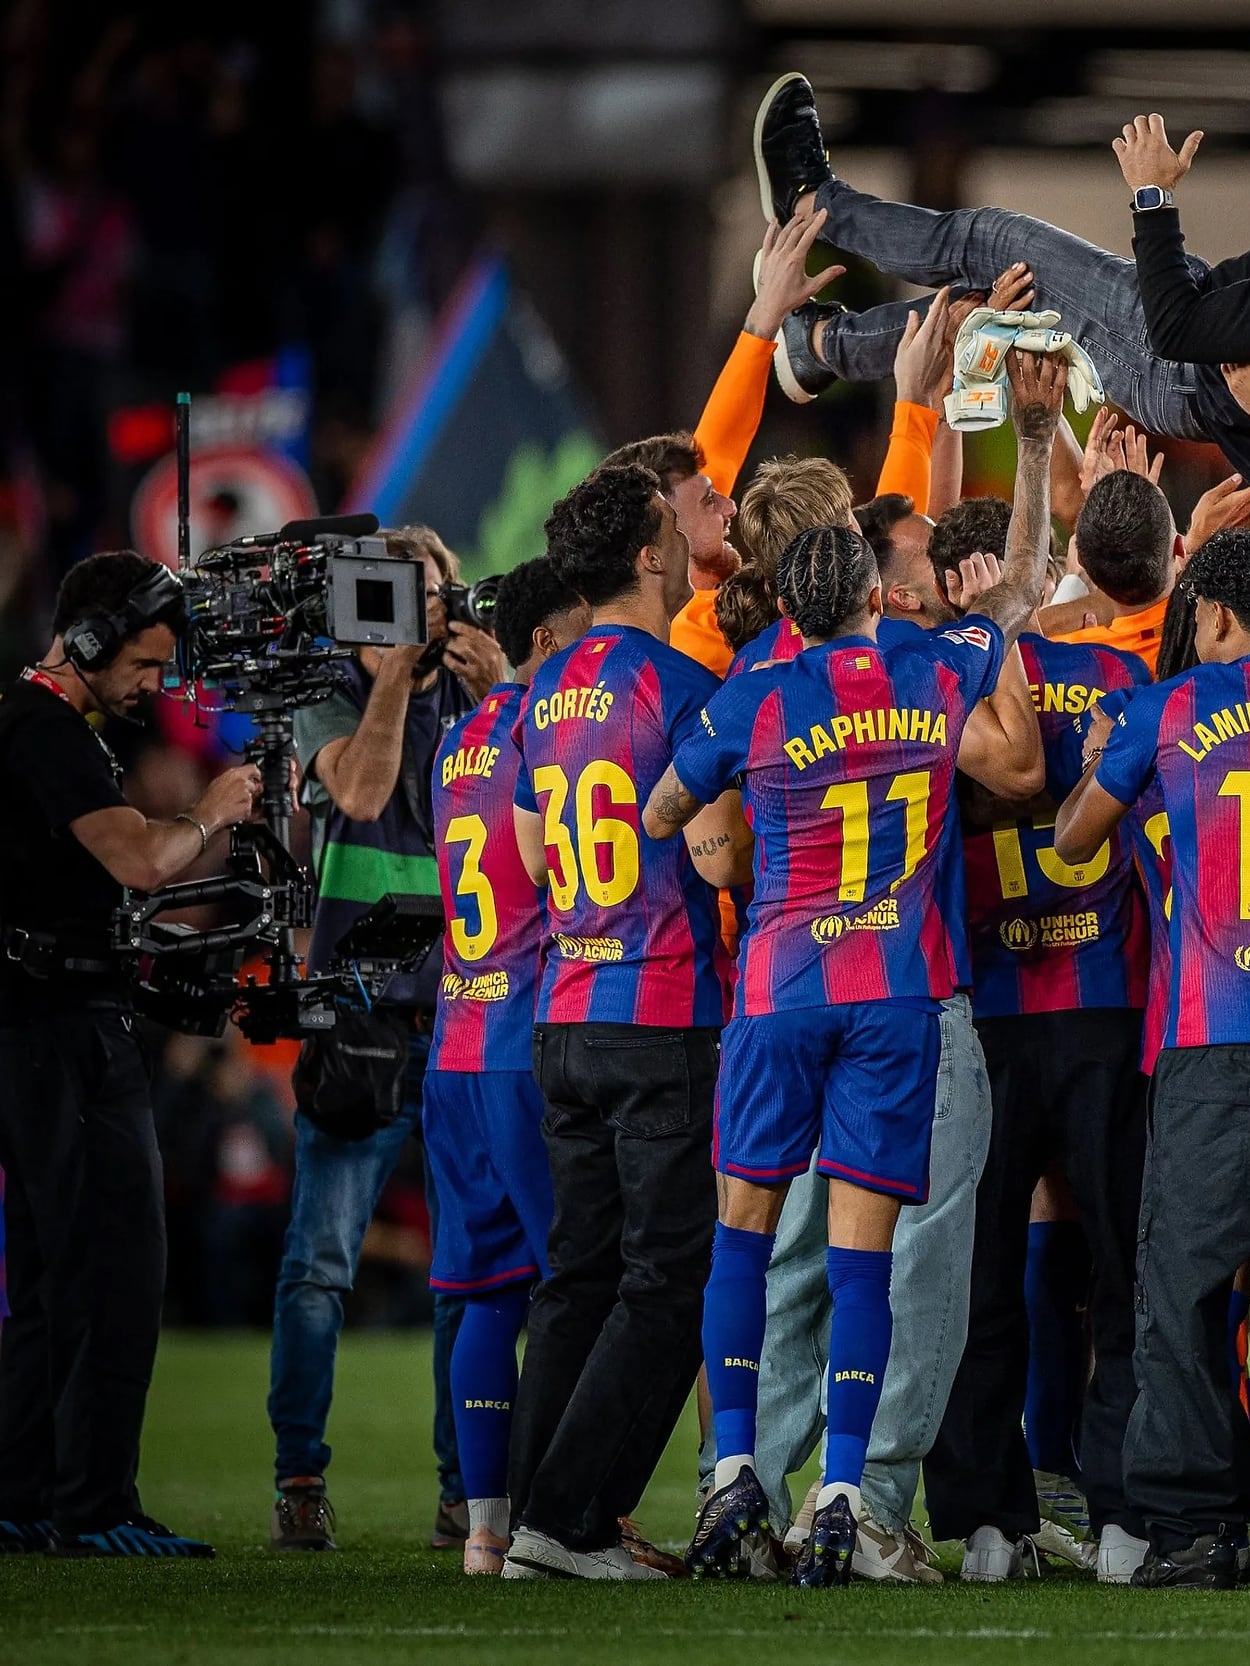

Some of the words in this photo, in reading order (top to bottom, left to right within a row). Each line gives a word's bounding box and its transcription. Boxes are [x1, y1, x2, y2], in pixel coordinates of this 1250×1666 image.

[534, 680, 614, 730] CORTÉS
[783, 708, 947, 771] RAPHINHA
[442, 745, 500, 788] BALDE
[534, 760, 639, 912] 36
[820, 771, 931, 902] 11
[444, 812, 498, 961] 3
[1040, 911, 1098, 929] UNHCR
[1041, 924, 1099, 942] ACNUR
[583, 946, 624, 961] ACNUR
[472, 970, 509, 989] UNHCR
